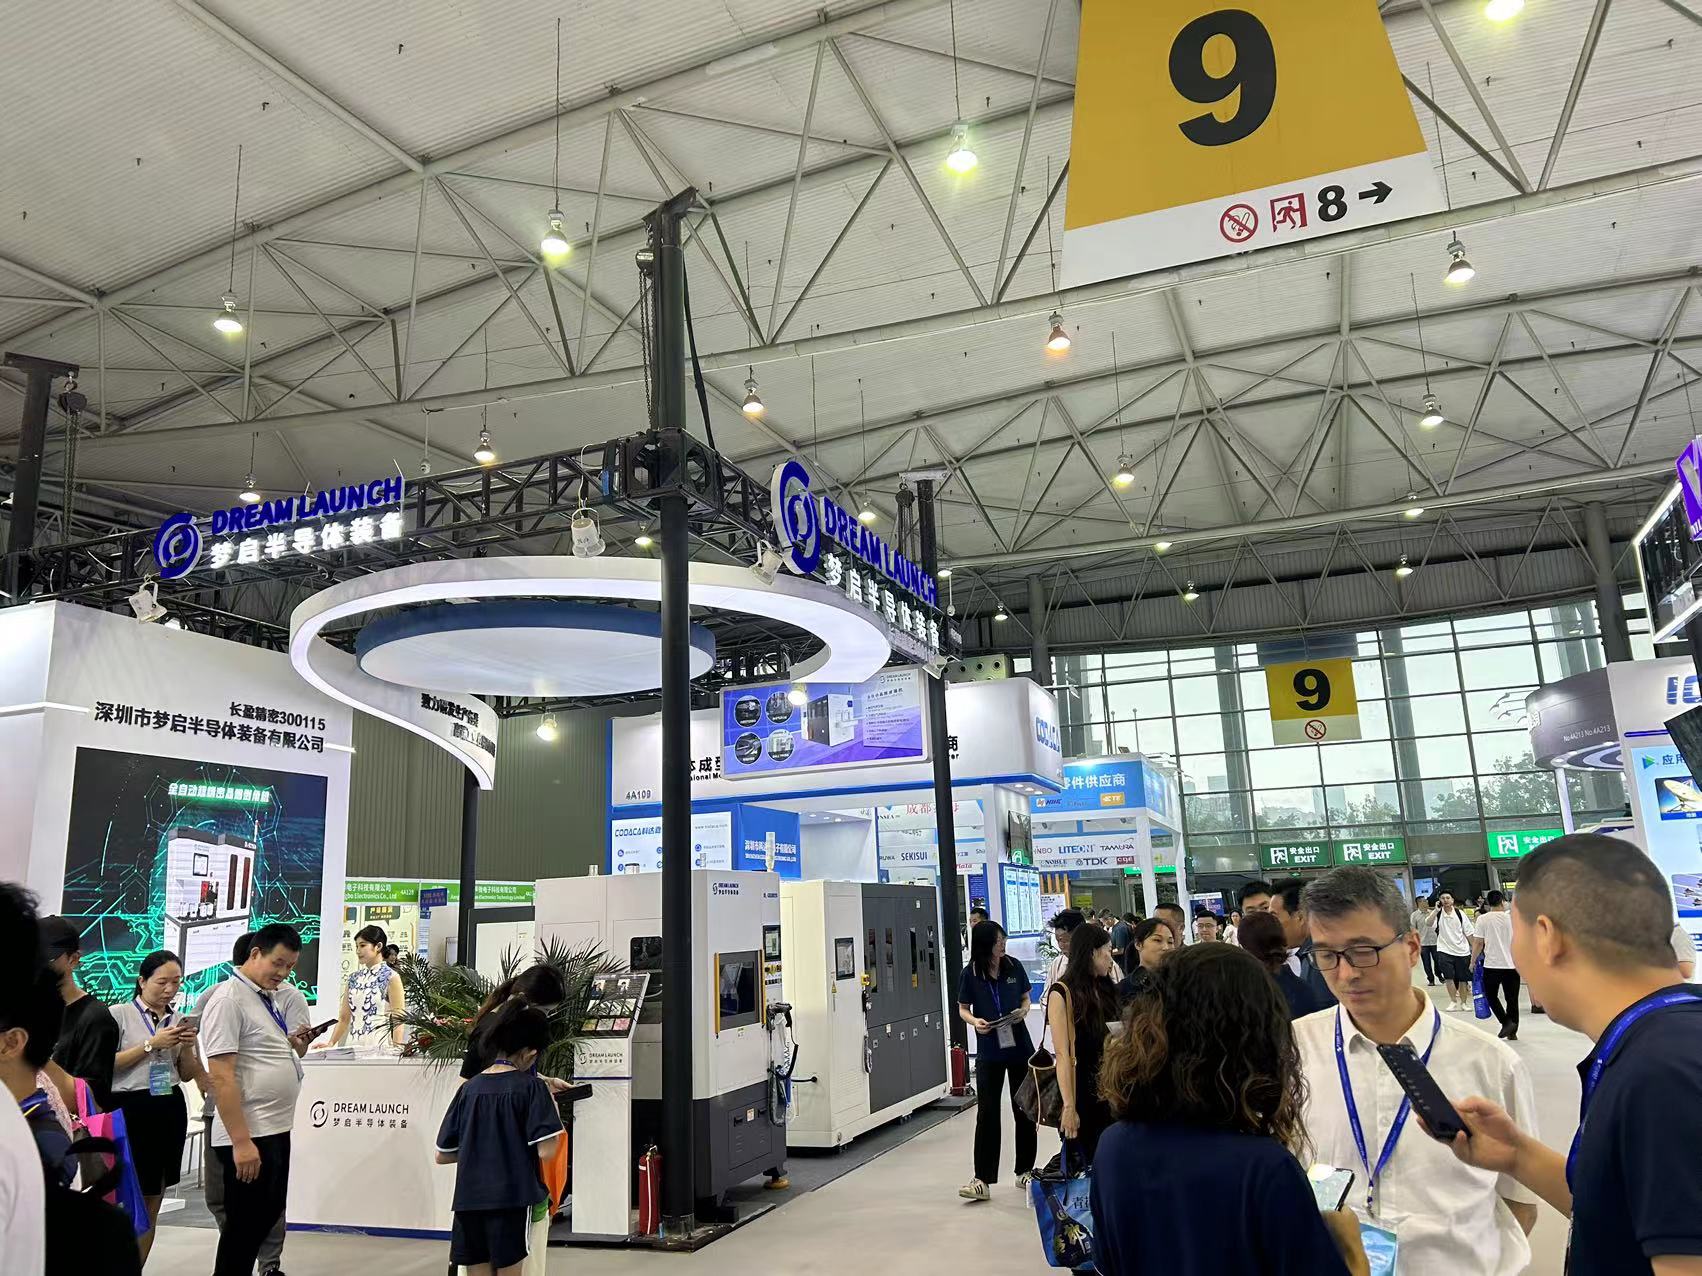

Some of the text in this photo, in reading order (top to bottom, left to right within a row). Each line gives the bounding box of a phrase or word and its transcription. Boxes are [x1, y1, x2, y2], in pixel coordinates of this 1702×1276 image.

[1168, 8, 1277, 147] 9
[1316, 184, 1348, 222] 8
[211, 475, 403, 535] DREAM LAUNCH
[211, 512, 404, 569] 梦启半导体装备
[821, 496, 937, 608] DREAM LAUNCH
[824, 551, 940, 649] 梦启半导体装备
[1292, 668, 1331, 711] 9
[93, 701, 325, 753] 深圳市梦启半导体装备有限公司
[229, 701, 326, 731] 长盈精密300115
[901, 851, 928, 861] SEKISUI
[1083, 857, 1108, 866] TDK
[1289, 846, 1320, 855] 安全出口
[1294, 855, 1317, 863] EXIT
[1363, 842, 1395, 852] 安全出口
[1368, 851, 1391, 860] EXIT
[333, 1102, 409, 1114] DREAM LAUNCH
[333, 1117, 408, 1129] 梦启半导体装备
